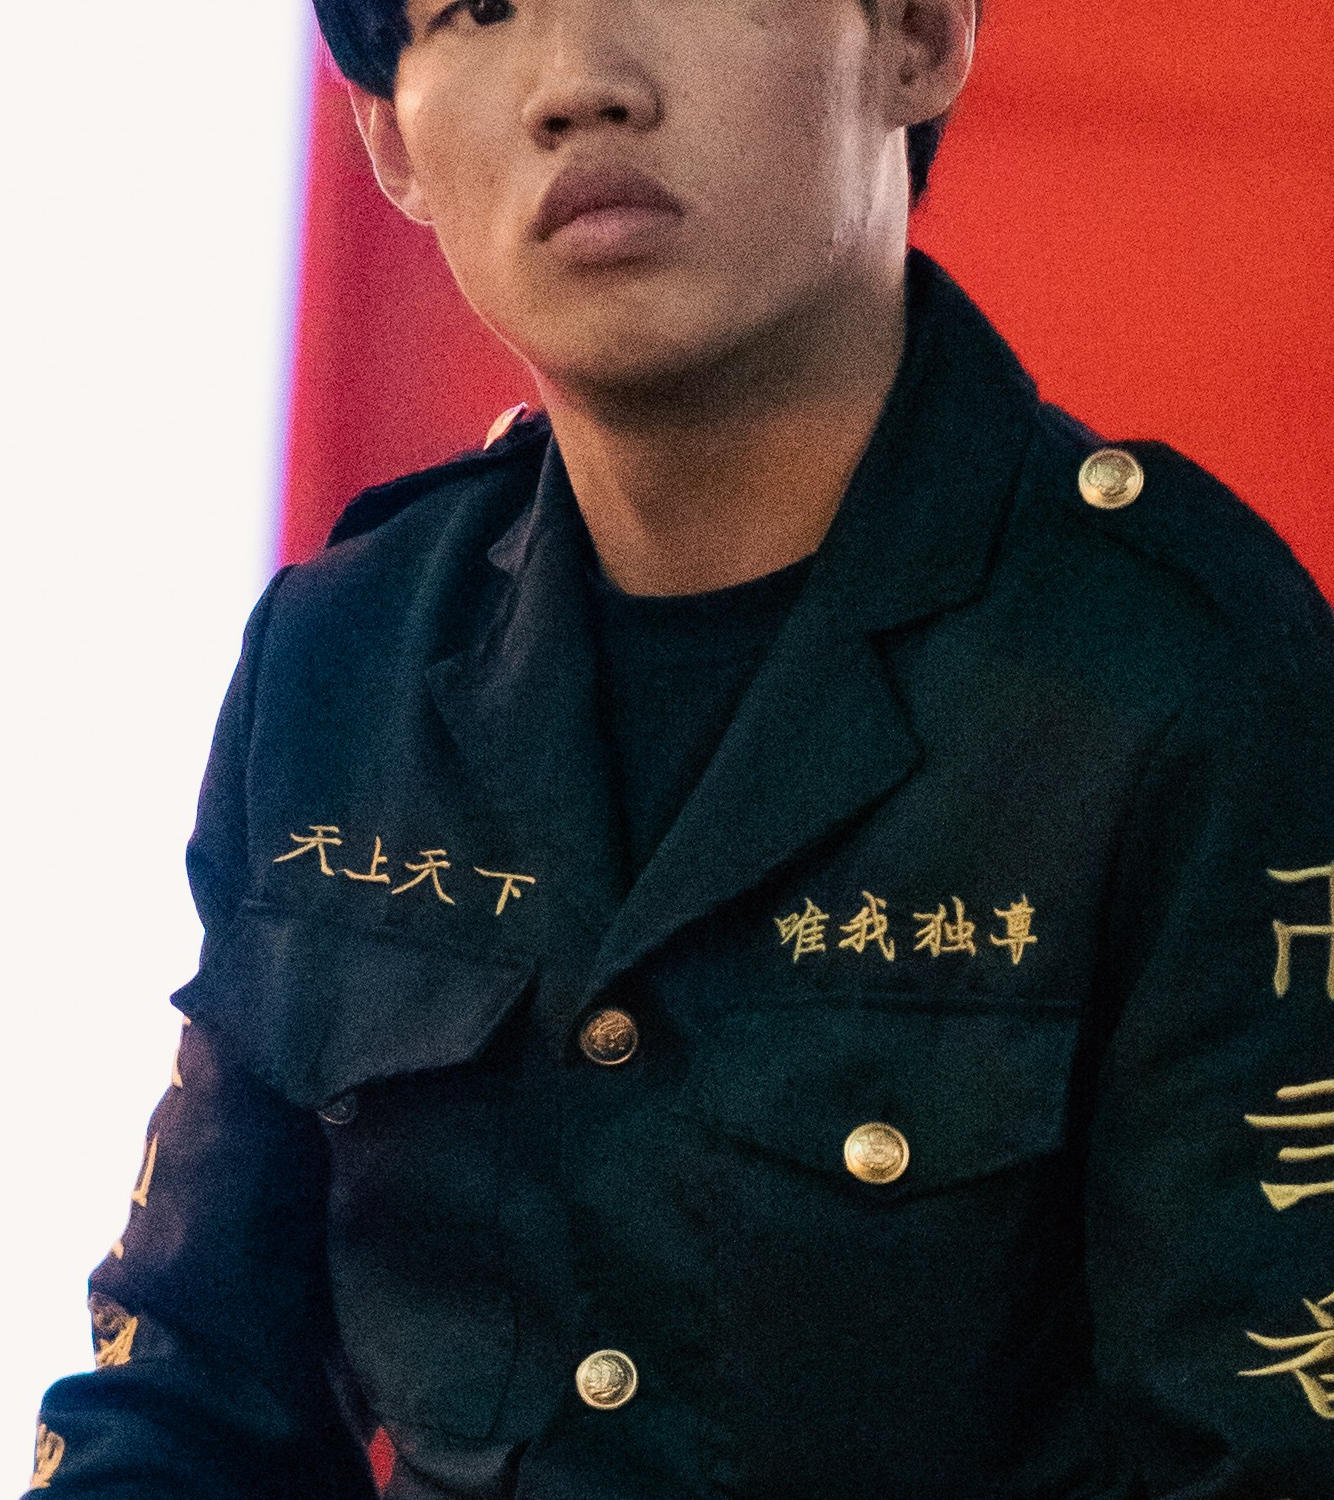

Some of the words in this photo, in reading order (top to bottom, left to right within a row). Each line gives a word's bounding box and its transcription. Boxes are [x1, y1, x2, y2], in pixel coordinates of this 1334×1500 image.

[273, 825, 536, 916] 天上天下
[773, 889, 1038, 965] 唯我独尊
